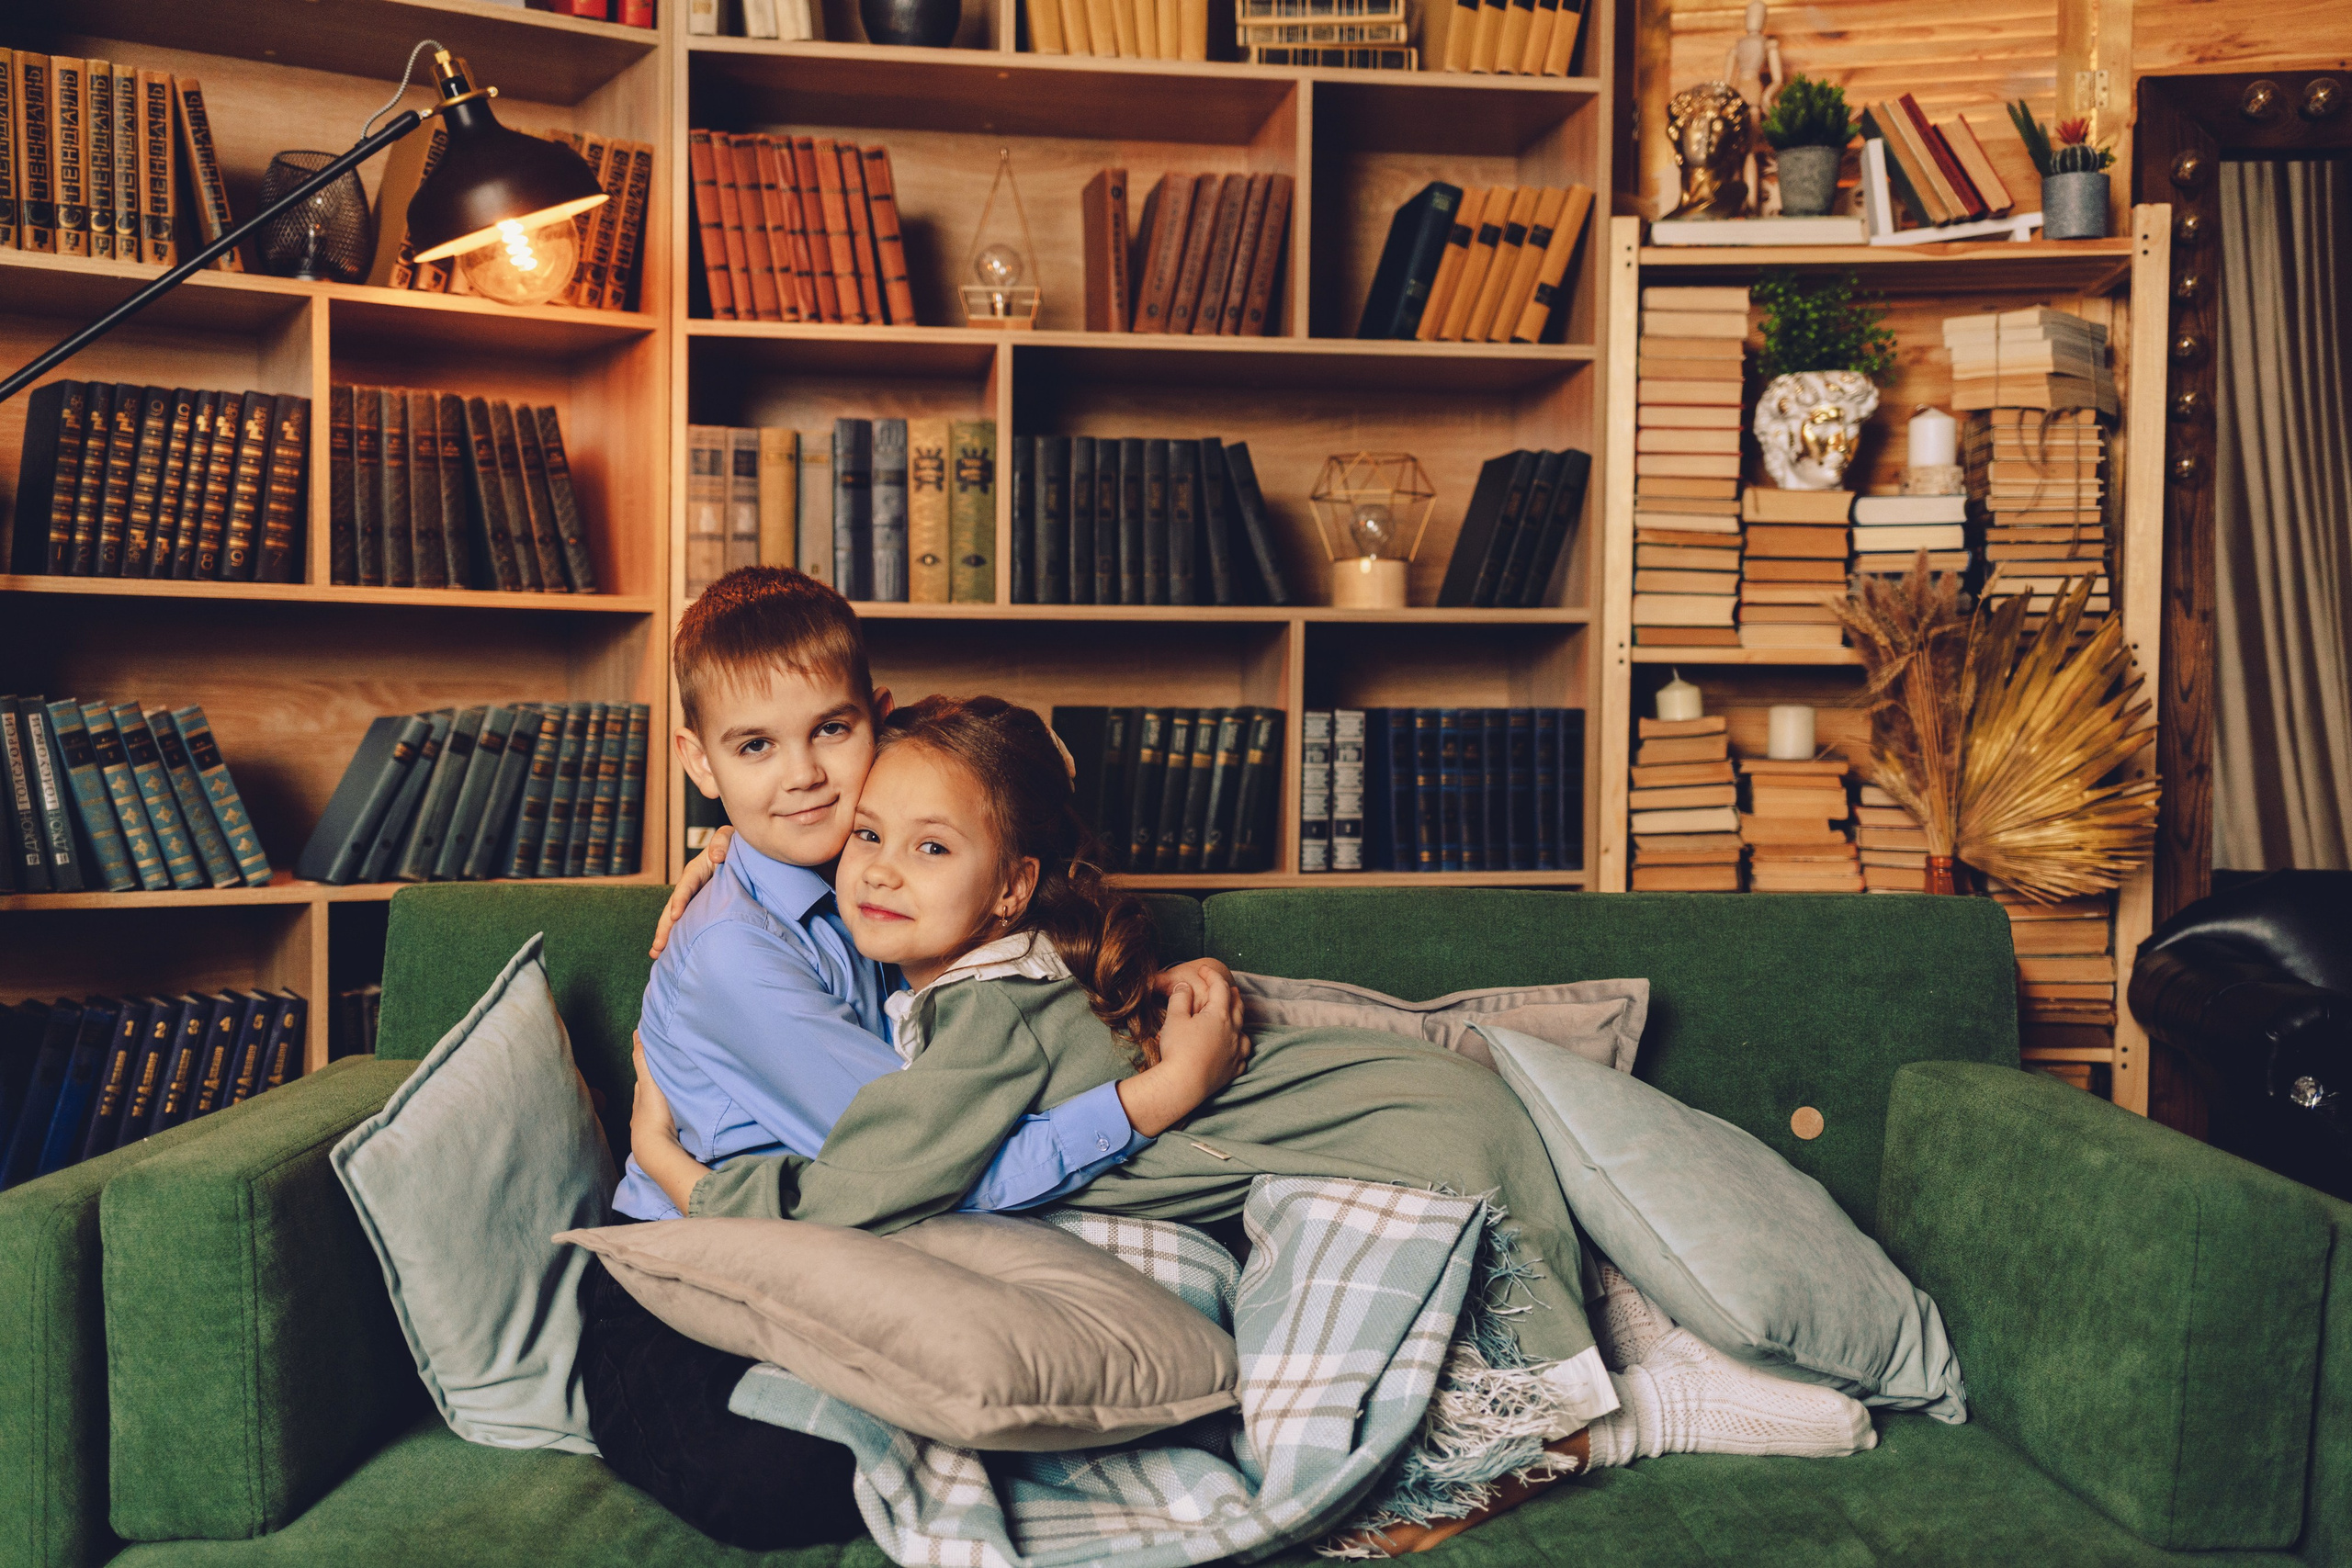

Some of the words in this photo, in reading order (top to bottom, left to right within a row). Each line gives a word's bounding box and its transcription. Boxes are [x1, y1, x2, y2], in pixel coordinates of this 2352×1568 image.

[27, 68, 50, 221] СТЕНДАЛЬ
[58, 73, 84, 229] СТЕНДАЛЬ
[90, 78, 111, 232] СТЕНДАЛЬ
[115, 80, 136, 235] СТЕНДАЛЬ
[147, 86, 172, 238] СТЕНДАЛЬ
[200, 553, 213, 570] 8
[231, 550, 244, 567] 9
[5, 715, 28, 805] ГОЛСУОРСИ
[32, 716, 58, 807] ГОЛСУОРСИ
[19, 811, 40, 852] ДЖОН
[48, 811, 69, 853] ДЖОН
[124, 1020, 134, 1037] 1
[154, 1021, 166, 1039] 2
[187, 1019, 200, 1035] 3
[220, 1016, 231, 1032] 4
[253, 1013, 265, 1030] 5
[283, 1012, 294, 1029] 6
